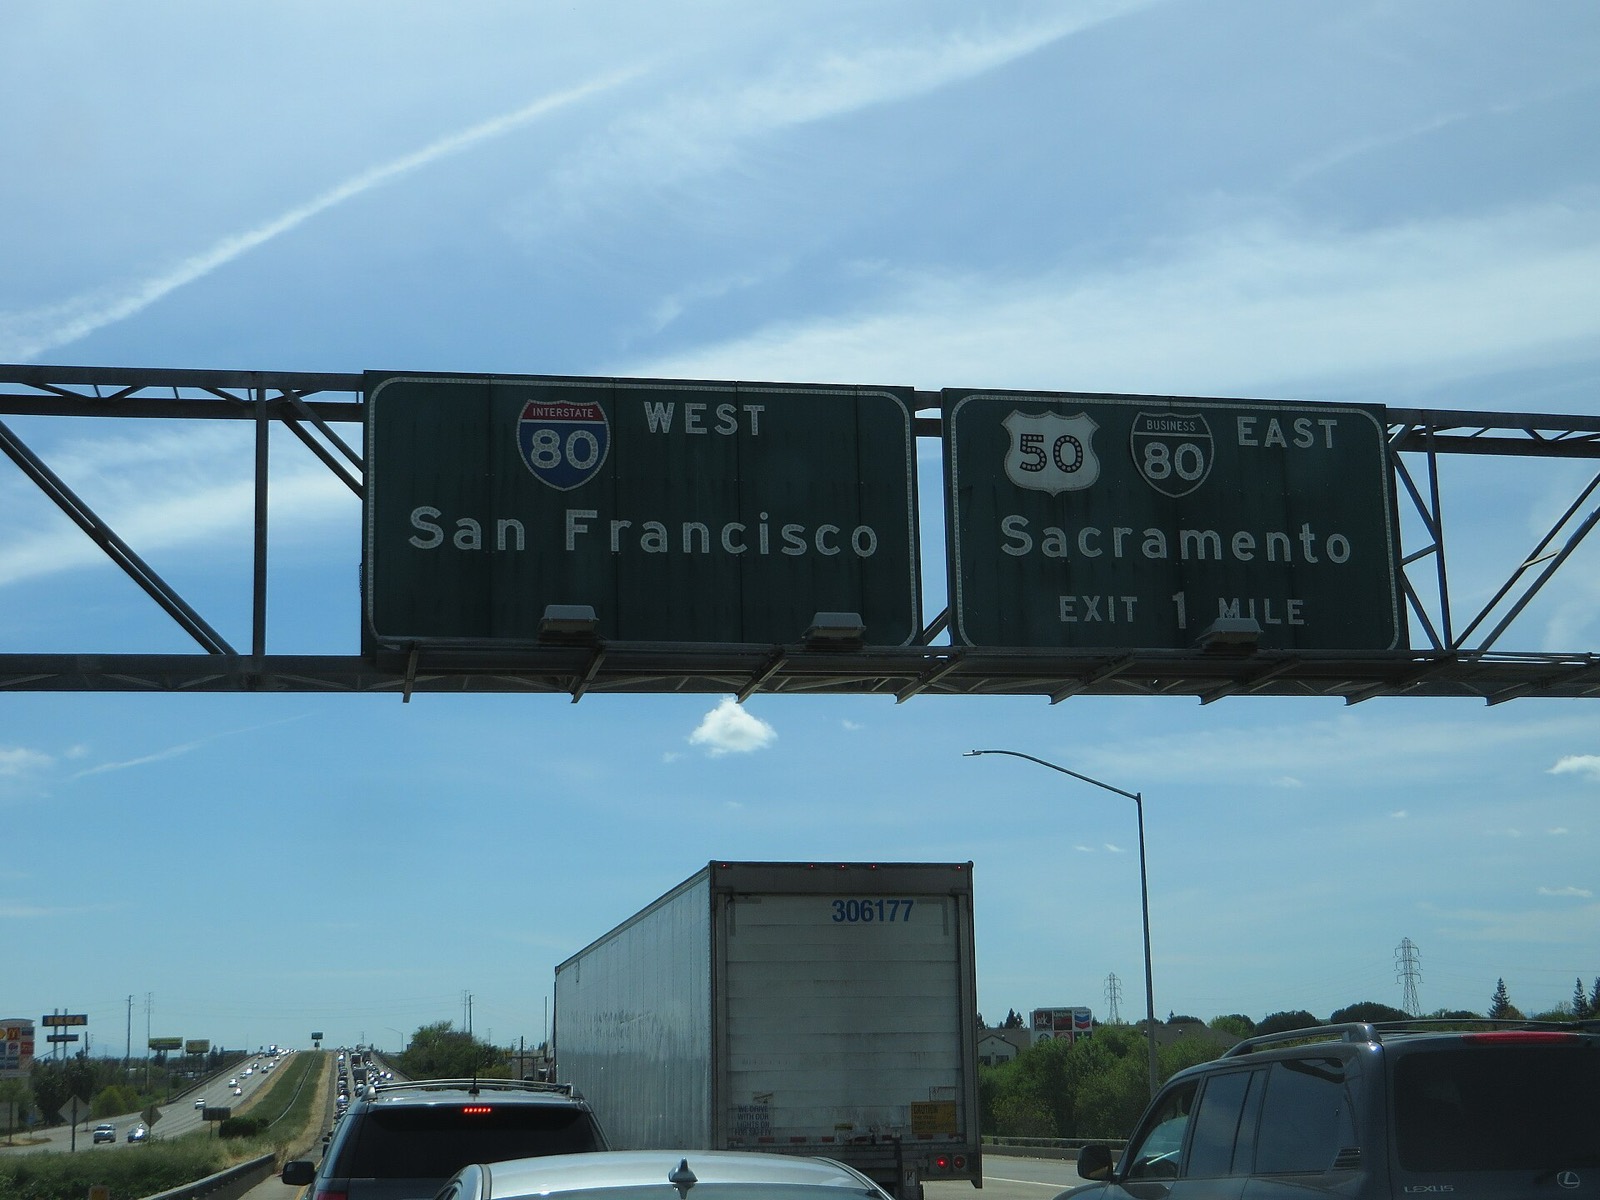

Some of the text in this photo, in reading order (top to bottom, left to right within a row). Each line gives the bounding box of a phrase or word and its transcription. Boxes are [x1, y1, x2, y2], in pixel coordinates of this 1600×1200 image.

[532, 407, 594, 418] INTERSTATE
[644, 401, 765, 436] WEST
[1146, 420, 1196, 432] BUSINESS
[531, 428, 599, 470] 80
[1237, 416, 1338, 449] EAST
[1019, 433, 1083, 473] 50
[1144, 442, 1203, 481] 80
[409, 506, 879, 558] San Francisco
[1001, 514, 1352, 564] Sacramento
[1060, 591, 1304, 629] EXIT 1 MILE
[832, 899, 914, 923] 306177
[1403, 1184, 1455, 1193] LEXUS
